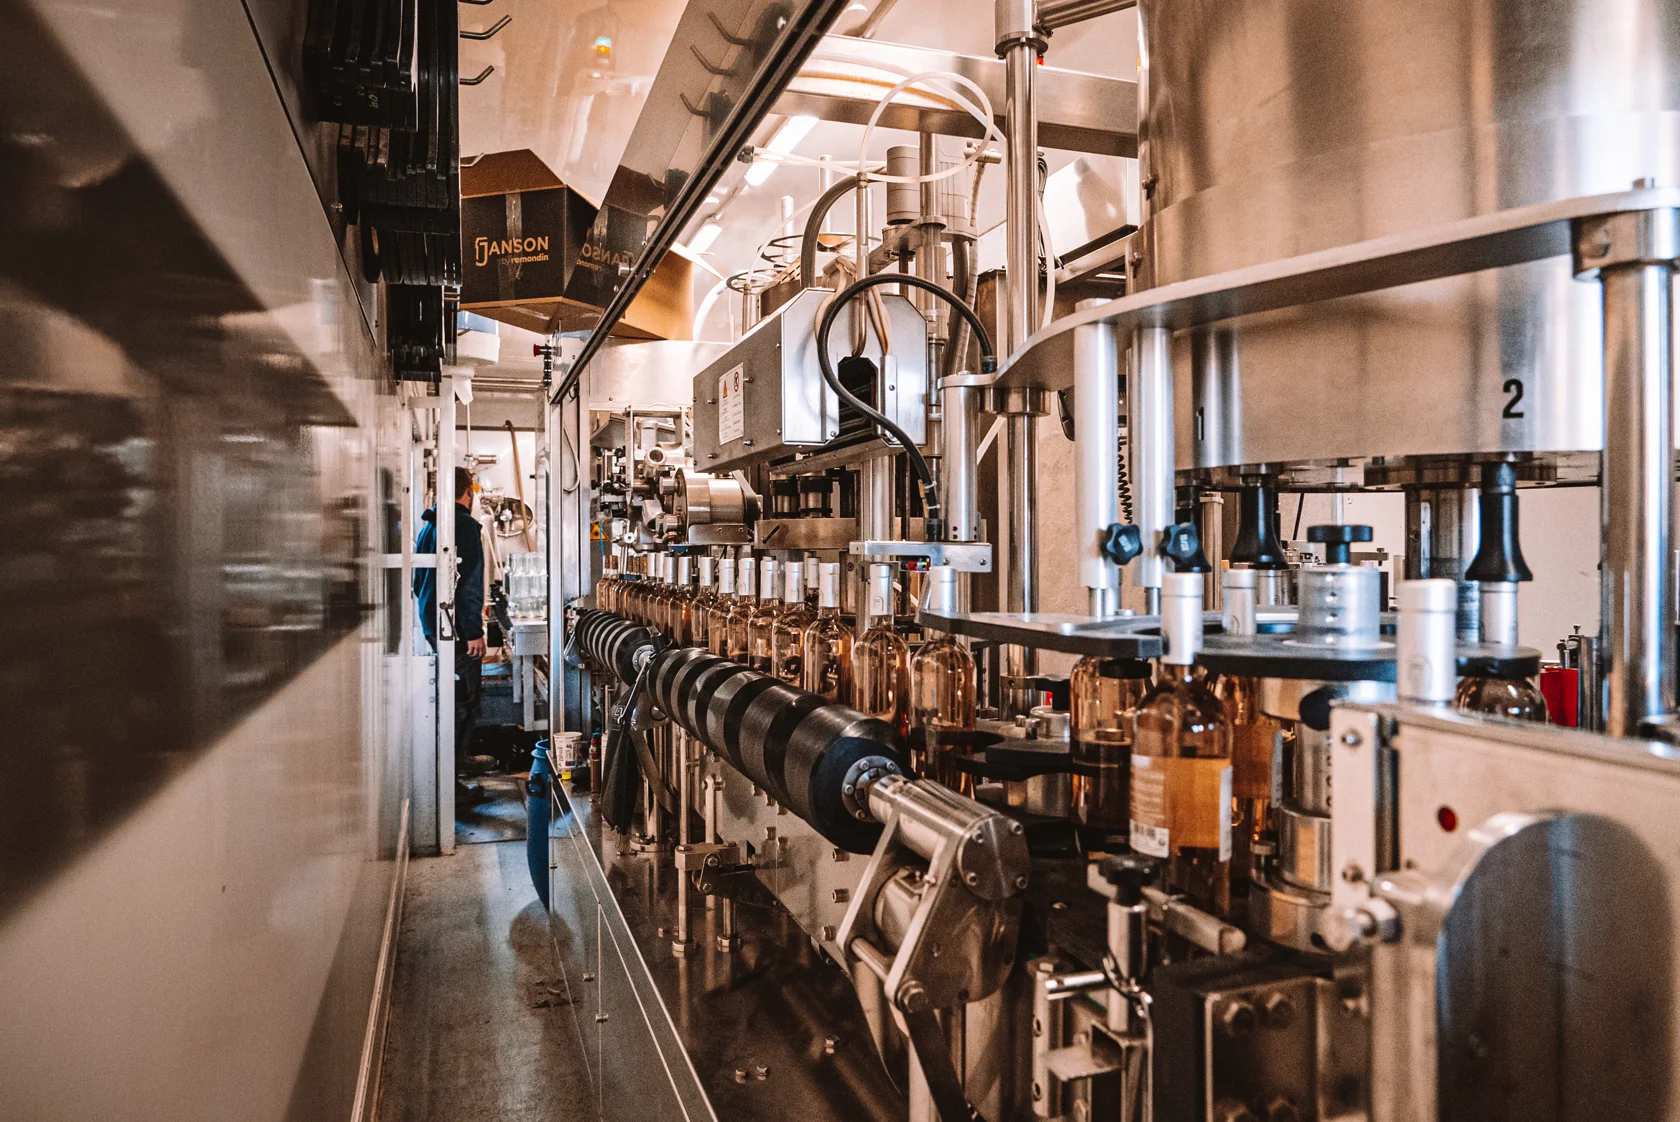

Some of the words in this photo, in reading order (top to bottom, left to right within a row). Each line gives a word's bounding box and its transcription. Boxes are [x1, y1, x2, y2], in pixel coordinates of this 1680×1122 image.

[511, 252, 549, 264] ramondin
[1503, 379, 1524, 419] 2
[1196, 406, 1204, 440] 1
